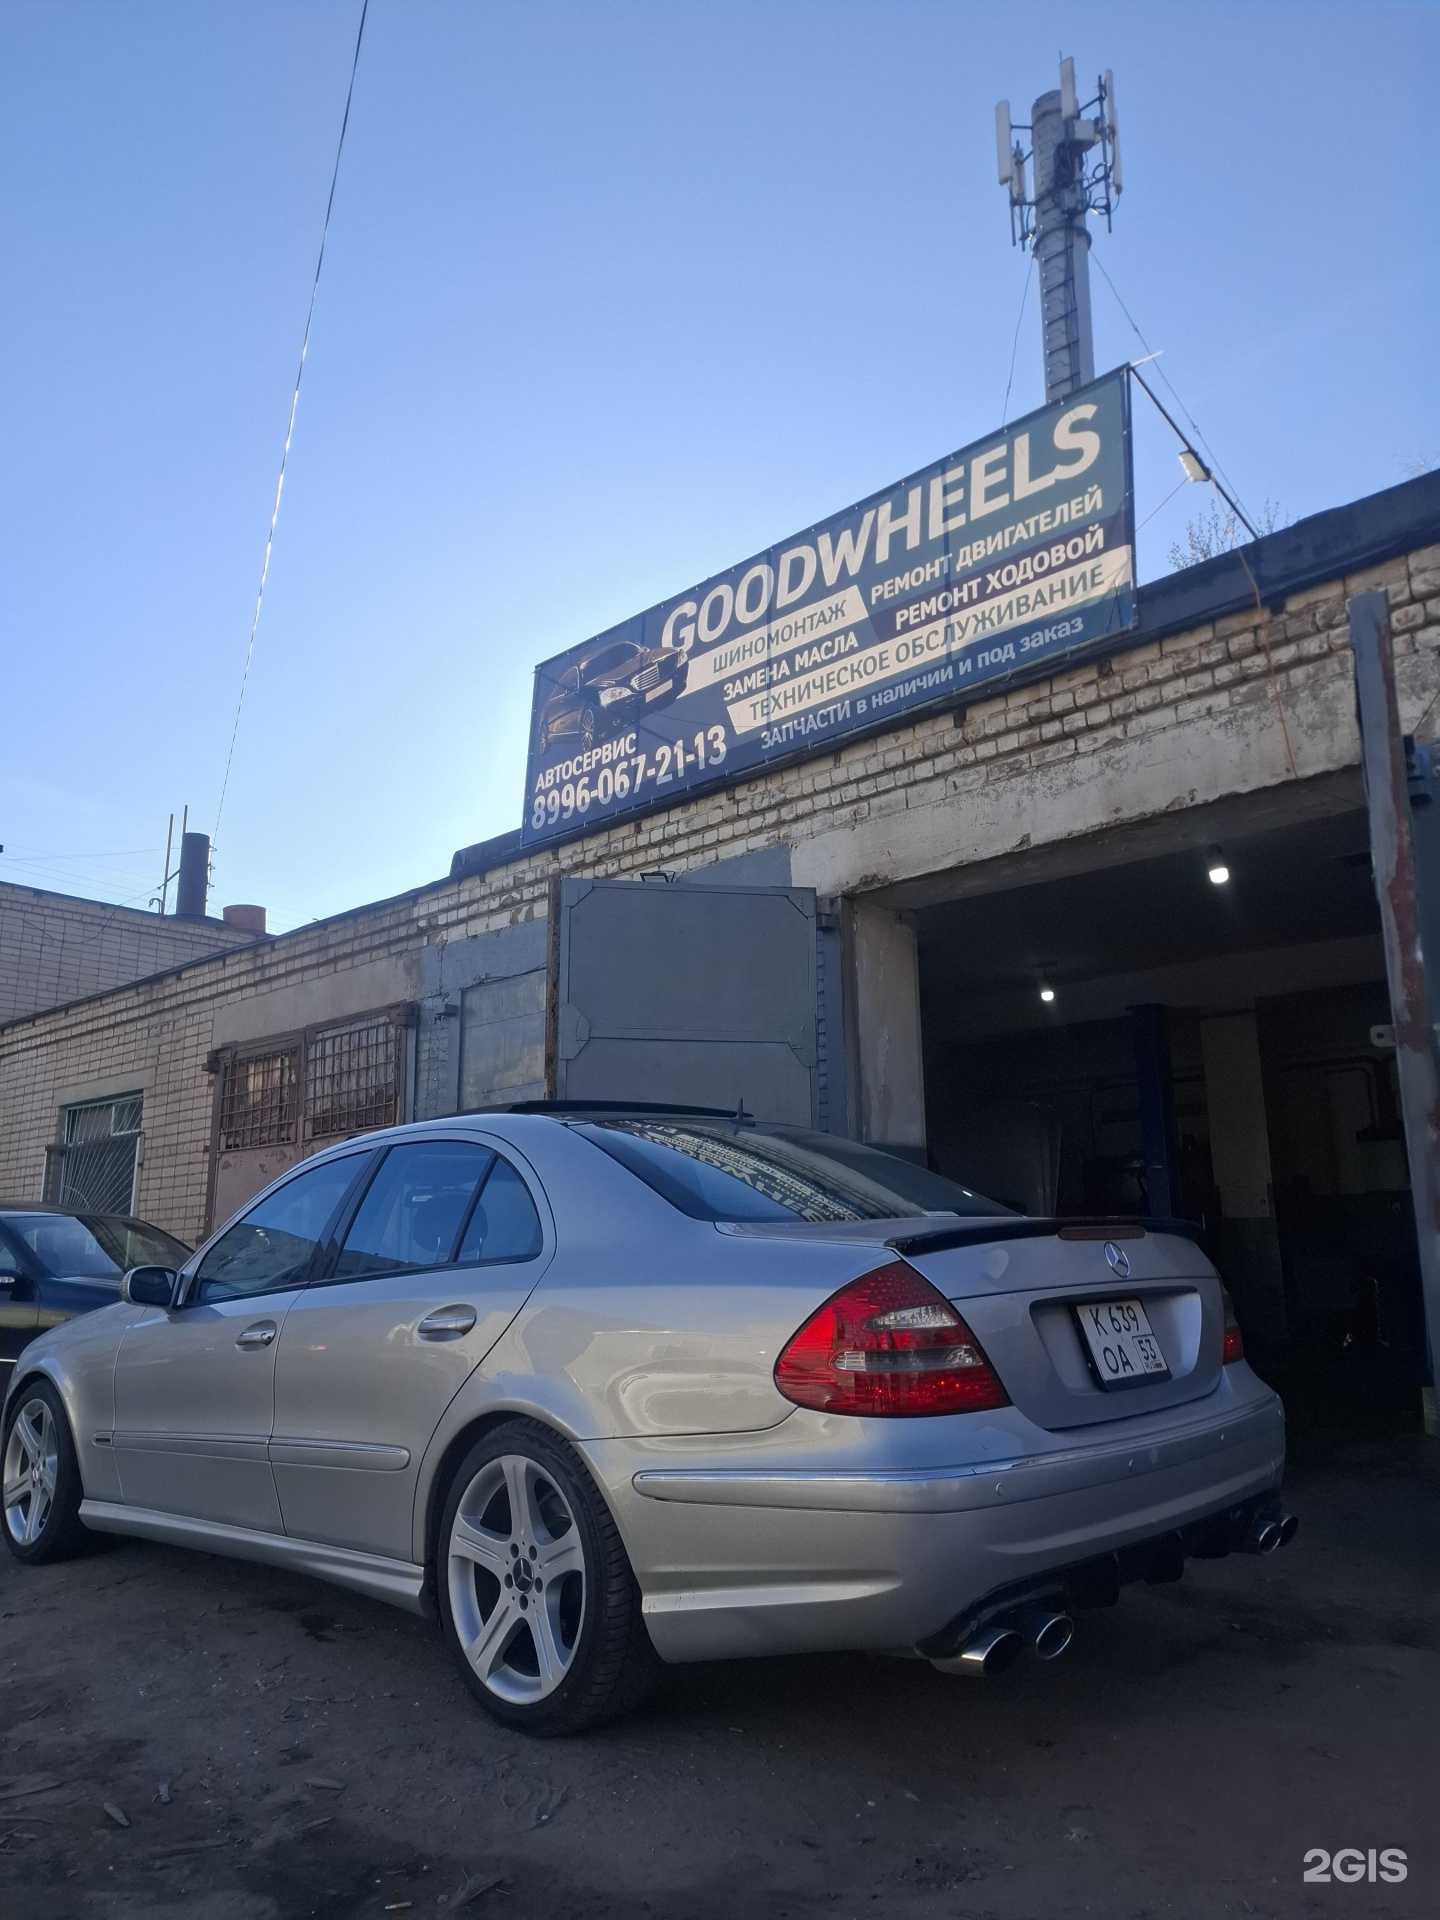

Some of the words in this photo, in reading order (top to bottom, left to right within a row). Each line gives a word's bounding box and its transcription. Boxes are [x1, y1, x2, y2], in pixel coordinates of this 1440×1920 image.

[661, 404, 1100, 654] GOODWHEELS
[871, 554, 952, 604] РЕМОНТ
[956, 484, 1103, 571] ДВИГАТЕЛЕЙ
[896, 578, 983, 630] РЕМОНТ
[986, 524, 1104, 594] ХОДОВОЙ
[713, 598, 846, 674] ШИНОМОНТАЖ
[723, 660, 790, 702] ЗАМЕНА
[795, 631, 859, 678] МАСЛА
[749, 650, 890, 721] ТЕХНИЧЕСКОЕ
[896, 564, 1105, 662] ОБСЛУЖИВАНИЕ
[761, 700, 850, 749] ЗАПЧАСТИ
[856, 697, 867, 713] в
[872, 667, 953, 708] наличии
[959, 658, 972, 674] и
[978, 642, 1015, 669] под
[1020, 616, 1084, 651] заказ
[531, 725, 727, 830] 8996-067-21-13
[535, 732, 637, 792] АВТОСЕРВИС
[1108, 1305, 1139, 1334] 639
